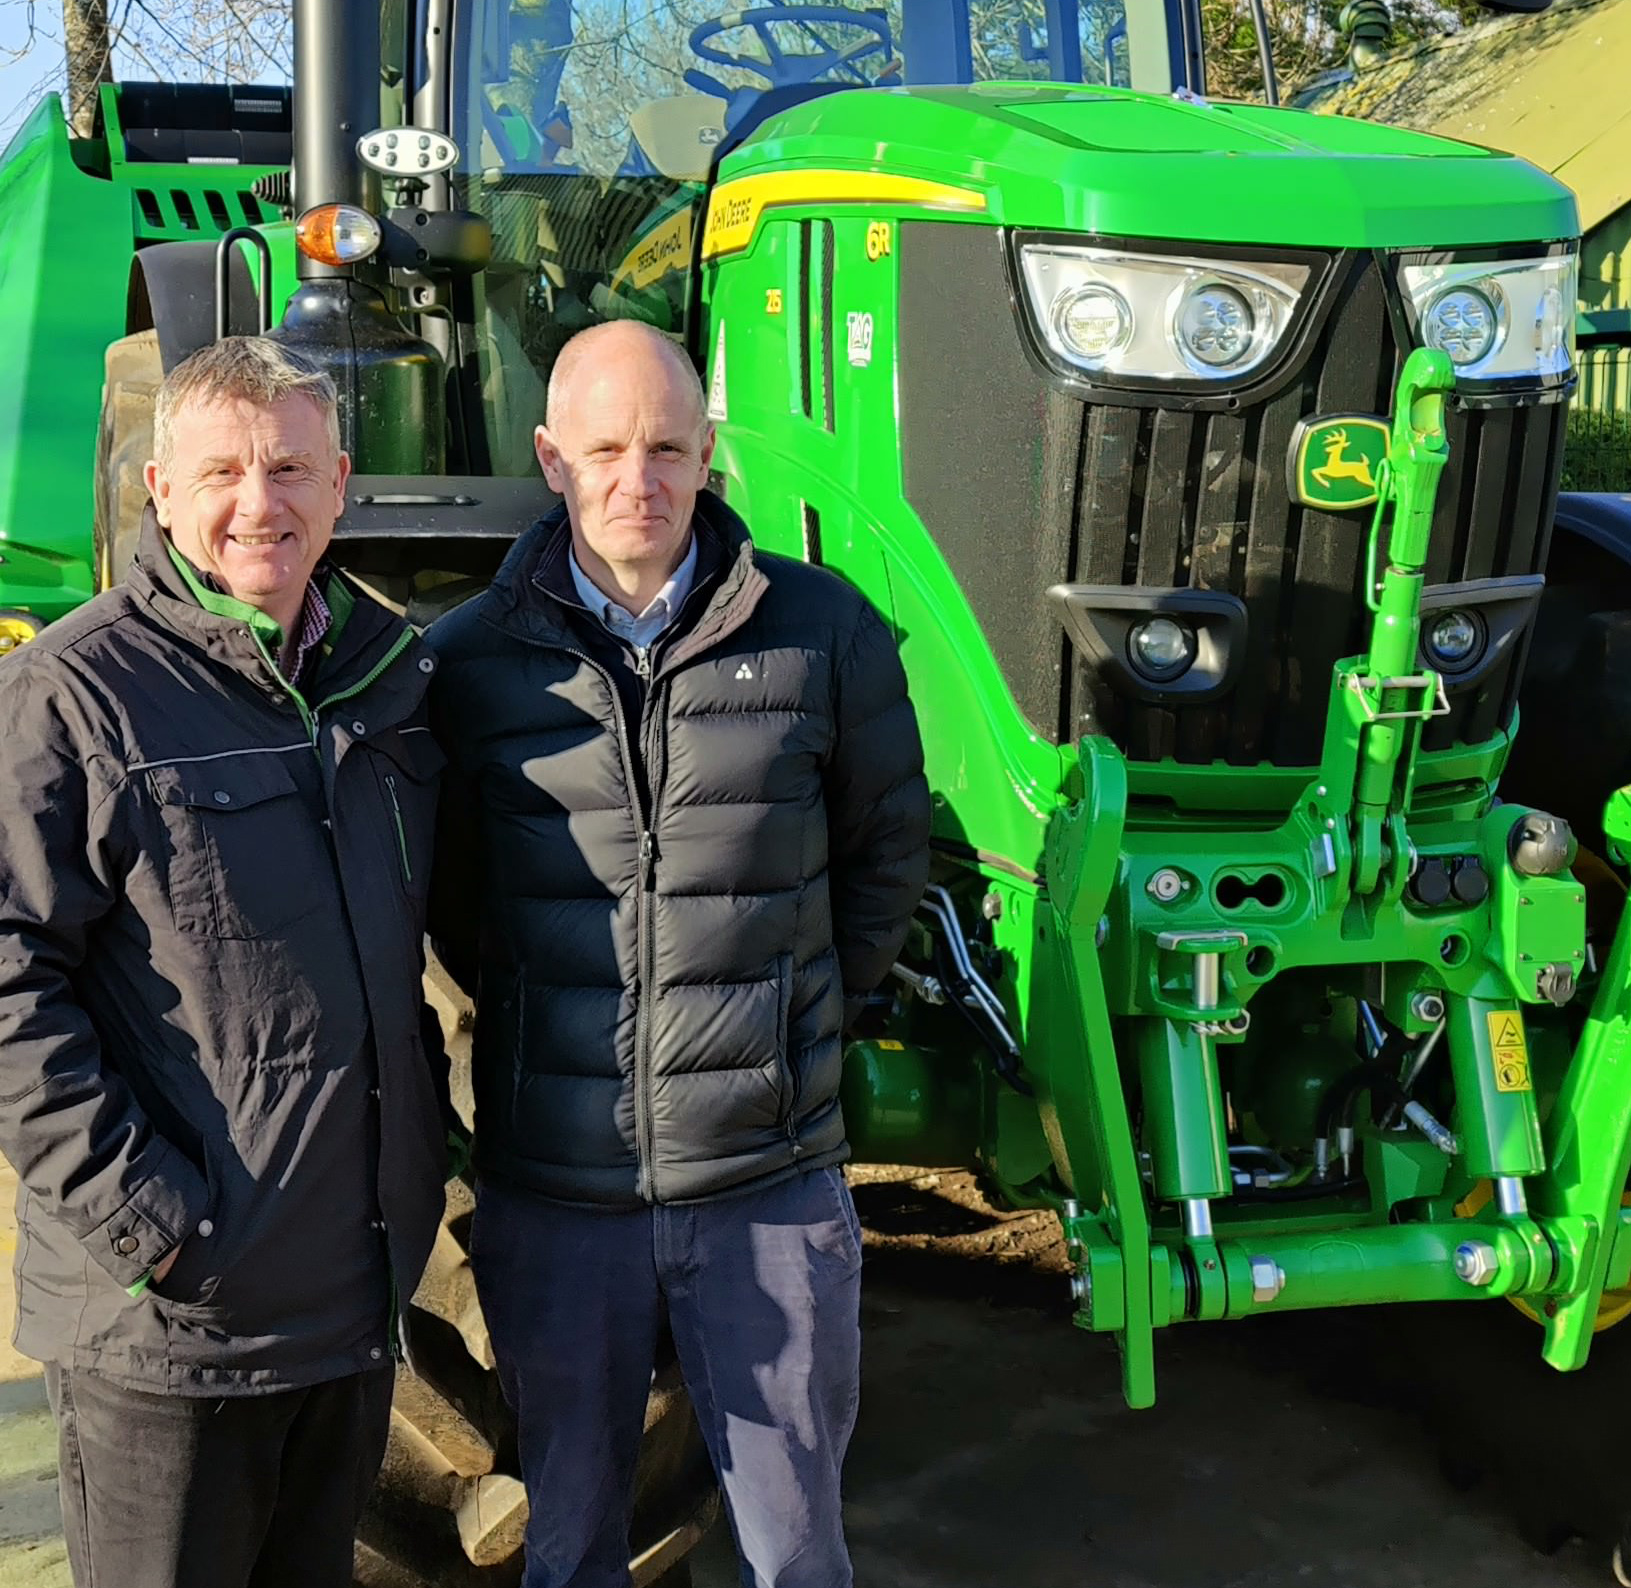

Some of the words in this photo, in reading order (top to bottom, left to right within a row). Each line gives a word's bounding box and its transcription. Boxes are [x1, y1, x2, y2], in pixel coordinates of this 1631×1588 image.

[711, 206, 727, 234] JOHN
[726, 197, 752, 228] DEERE
[867, 221, 890, 260] 6R
